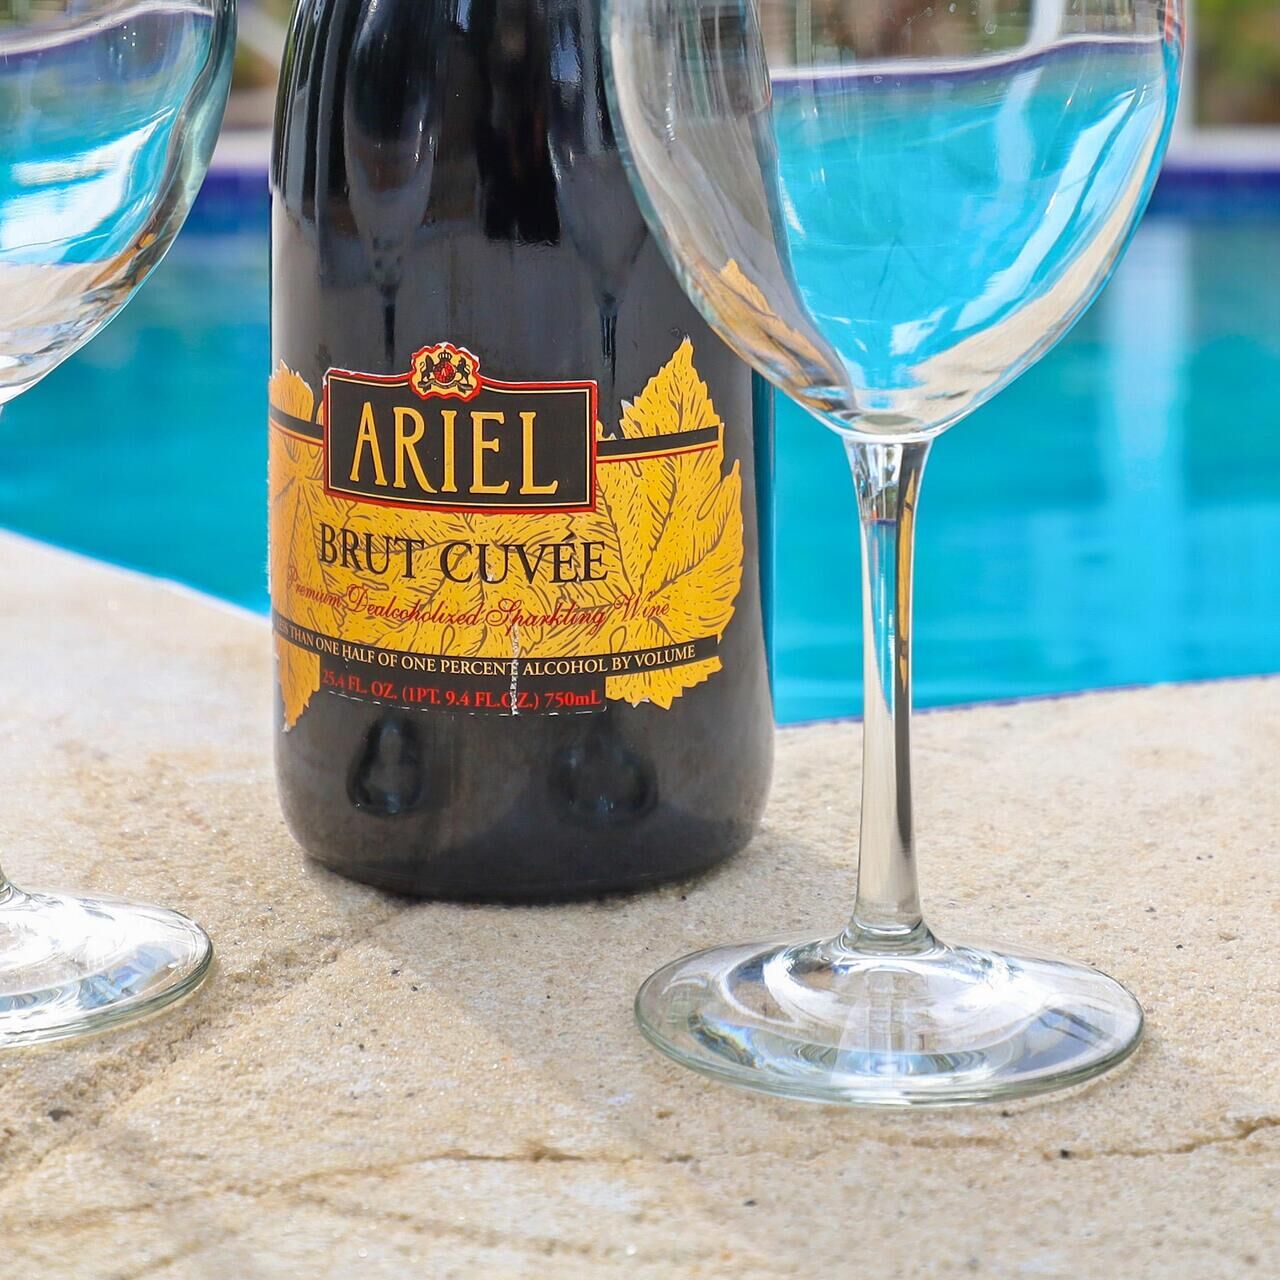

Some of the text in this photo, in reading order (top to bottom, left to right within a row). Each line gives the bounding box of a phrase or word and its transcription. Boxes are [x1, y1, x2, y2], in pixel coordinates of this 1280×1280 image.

[350, 401, 560, 495] ARIEL
[317, 523, 609, 585] BRUT CUVÉE
[287, 566, 670, 637] Premium Dealcoholized Sparkling Wine
[290, 624, 315, 647] THAN
[315, 637, 339, 657] ONE
[342, 643, 375, 664] HALF
[377, 652, 398, 668] OF
[401, 655, 437, 673] ONE
[440, 660, 518, 676] PERCENT
[522, 658, 609, 676] ALCOHOL
[611, 655, 632, 671] BY
[633, 644, 696, 668] VOLUME
[322, 669, 345, 689] 25.4
[348, 674, 369, 694] FL.
[371, 680, 398, 700] OZ.
[445, 689, 470, 707] 9.4
[544, 689, 602, 709] 750mL
